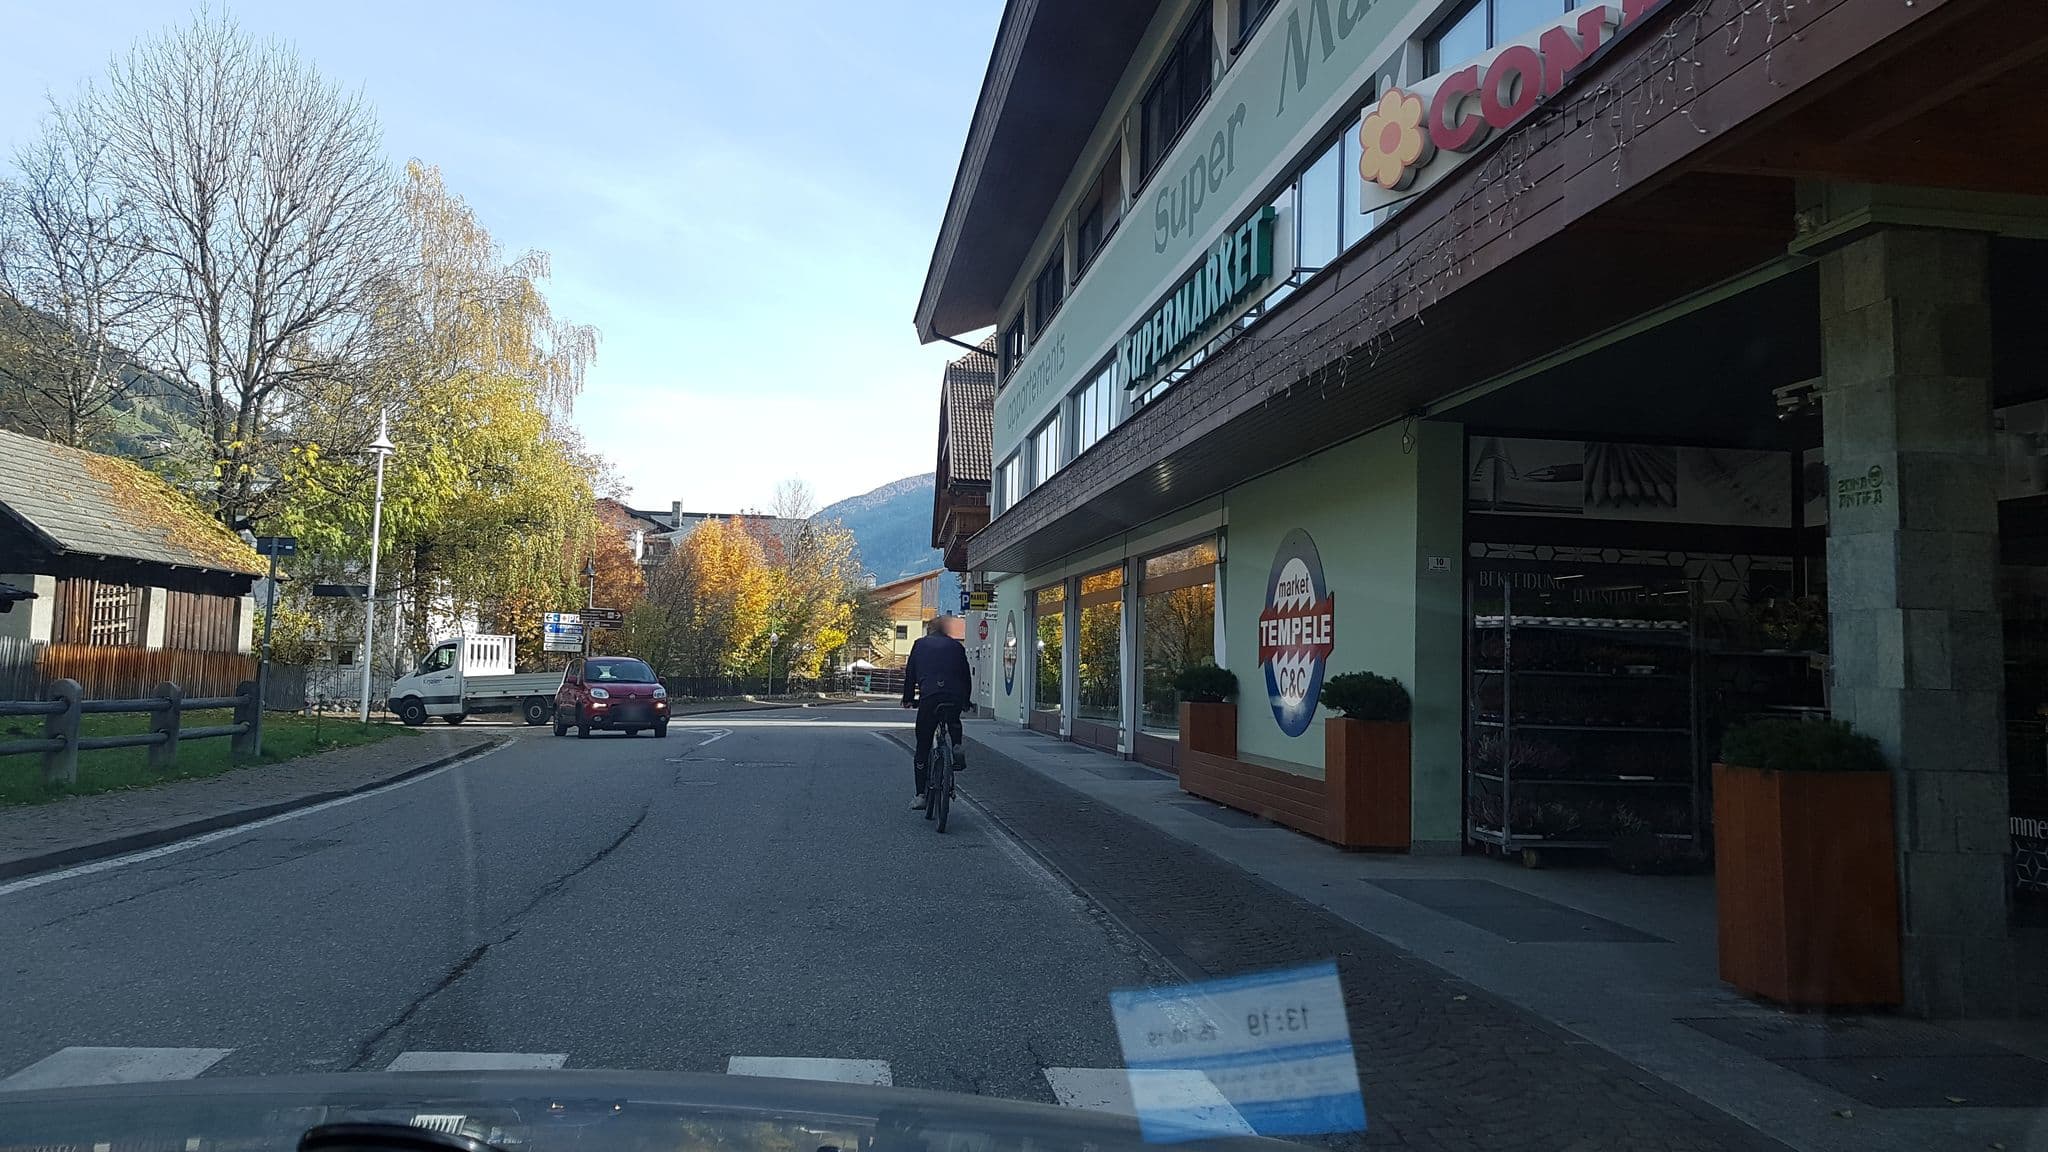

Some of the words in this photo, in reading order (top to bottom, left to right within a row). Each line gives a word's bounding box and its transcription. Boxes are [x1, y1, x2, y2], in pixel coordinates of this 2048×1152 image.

[1154, 102, 1247, 254] Super
[1119, 206, 1276, 390] SUPERMARKET
[1436, 558, 1444, 566] 10
[1279, 573, 1309, 598] market
[1479, 571, 1565, 590] BEKEIDUNG
[962, 595, 969, 607] P
[1260, 614, 1331, 647] TEMPELE
[1280, 667, 1306, 699] C&C
